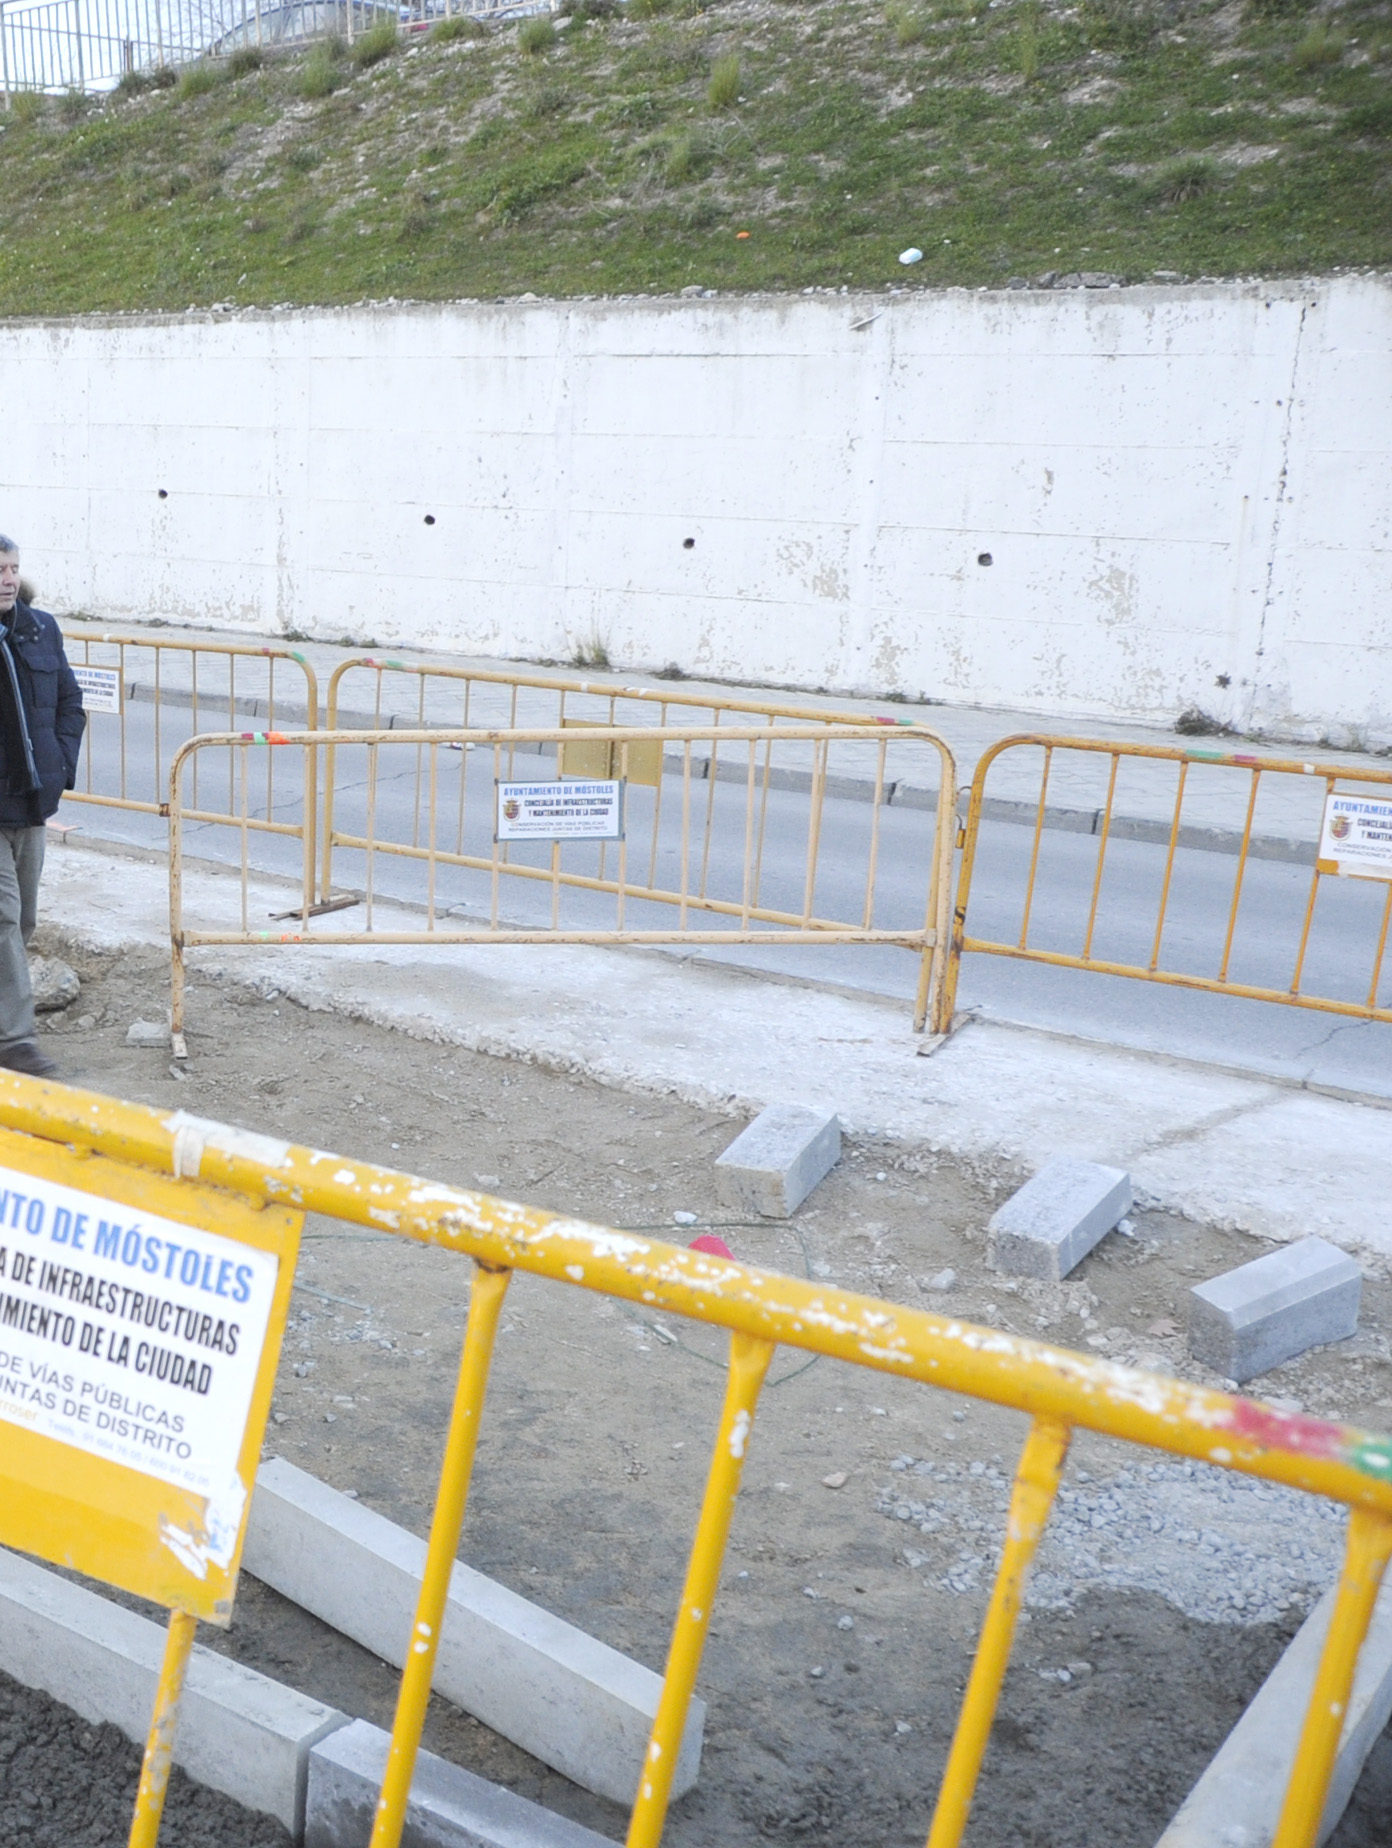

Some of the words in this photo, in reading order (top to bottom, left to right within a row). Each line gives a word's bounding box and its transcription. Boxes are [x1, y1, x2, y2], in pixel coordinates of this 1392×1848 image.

[51, 1206, 89, 1250] DE
[93, 1219, 254, 1304] MÓSTOLES
[11, 1250, 36, 1286] DE
[38, 1260, 241, 1356] INFRAESTRUCTURAS
[79, 1322, 105, 1357] DE
[107, 1331, 130, 1367] LA
[135, 1341, 213, 1395] CIUDAD
[29, 1361, 75, 1393] VÍAS
[81, 1381, 185, 1433] PÚBLICAS
[63, 1398, 91, 1423] DE
[96, 1411, 192, 1459] DISTRITO
